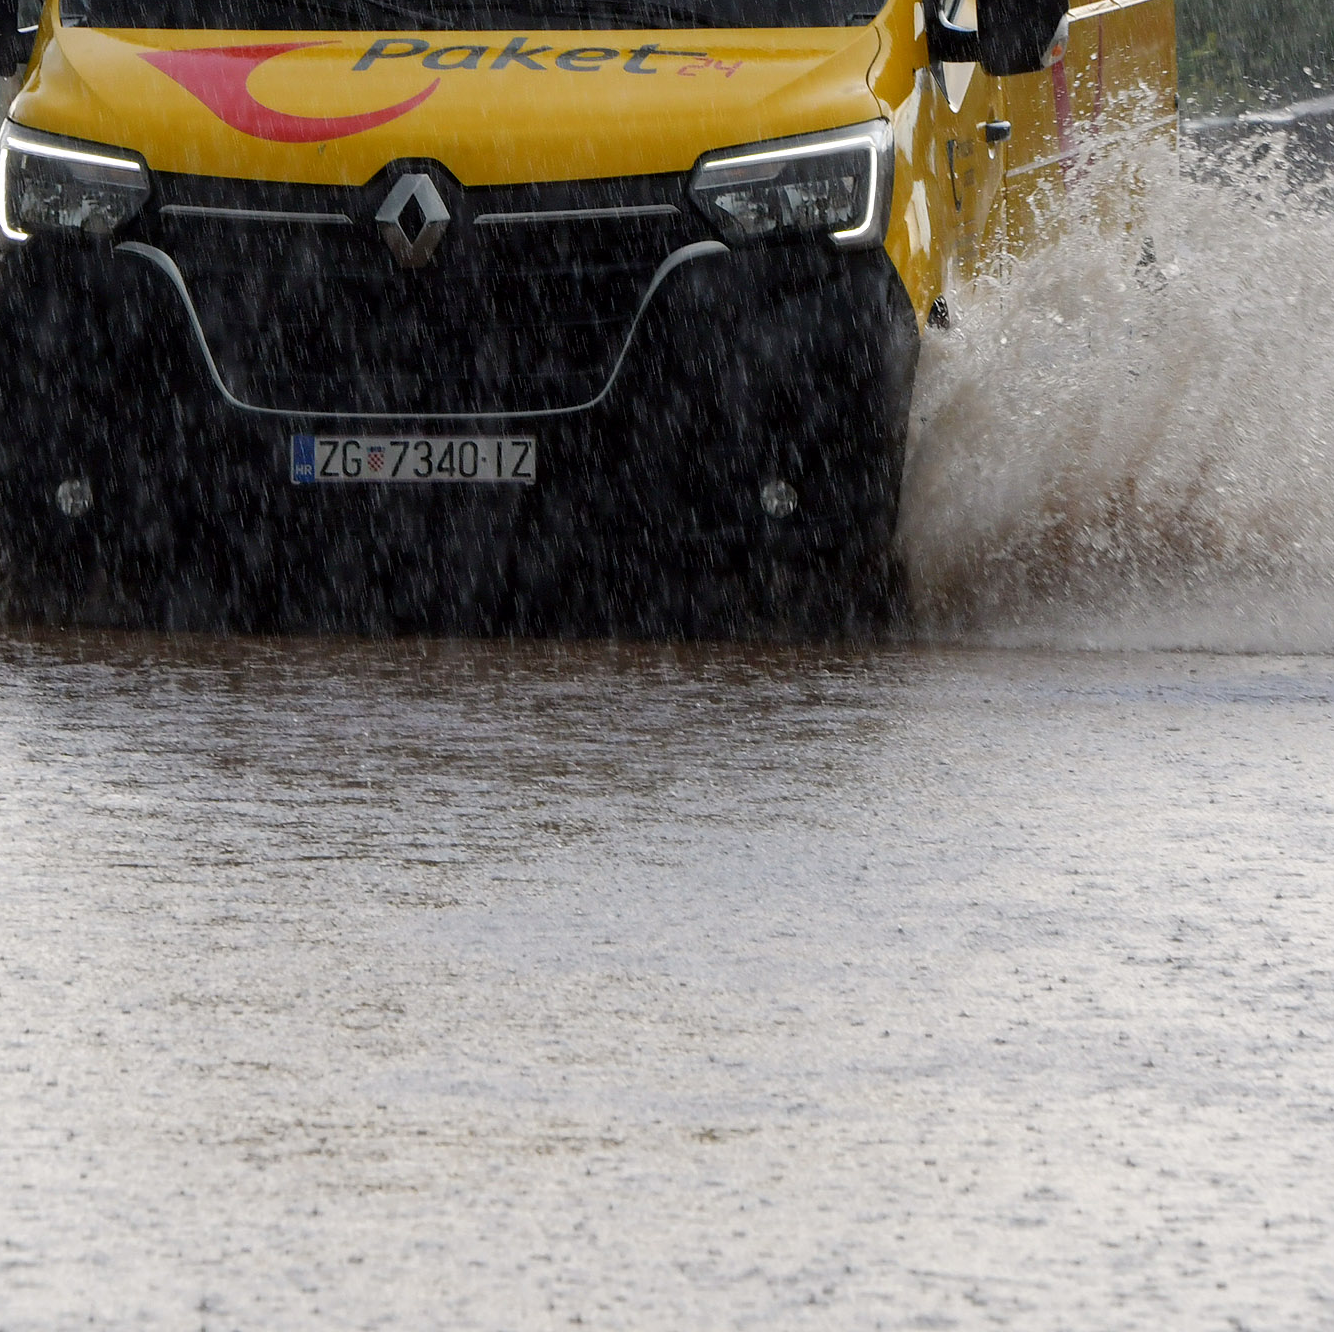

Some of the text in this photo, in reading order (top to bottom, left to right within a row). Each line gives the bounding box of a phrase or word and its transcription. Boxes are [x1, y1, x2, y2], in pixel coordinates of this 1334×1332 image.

[351, 37, 743, 79] Paket 24
[295, 465, 312, 475] HR
[319, 441, 362, 477] ZG
